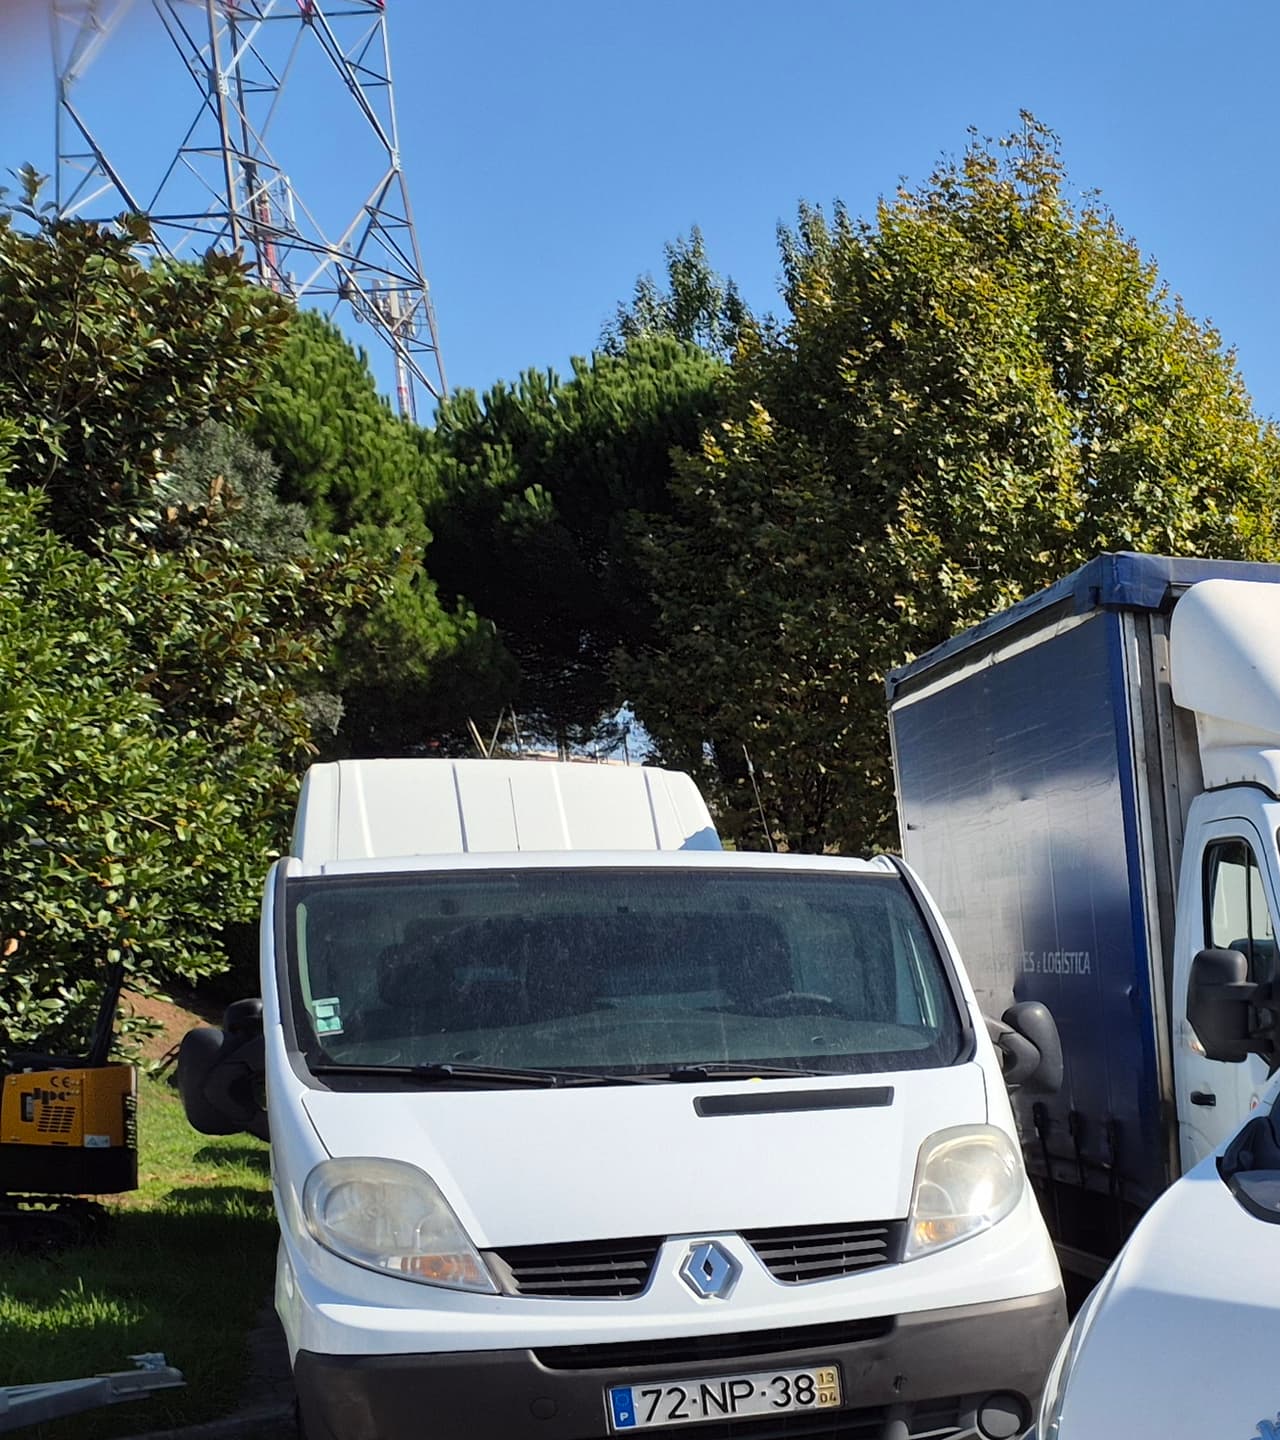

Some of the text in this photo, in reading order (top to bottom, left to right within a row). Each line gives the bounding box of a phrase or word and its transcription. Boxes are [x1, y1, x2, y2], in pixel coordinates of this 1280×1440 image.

[1043, 947, 1091, 974] LOGÍSTICA
[819, 1372, 835, 1384] 13
[820, 1391, 837, 1404] 04
[620, 1412, 629, 1422] P
